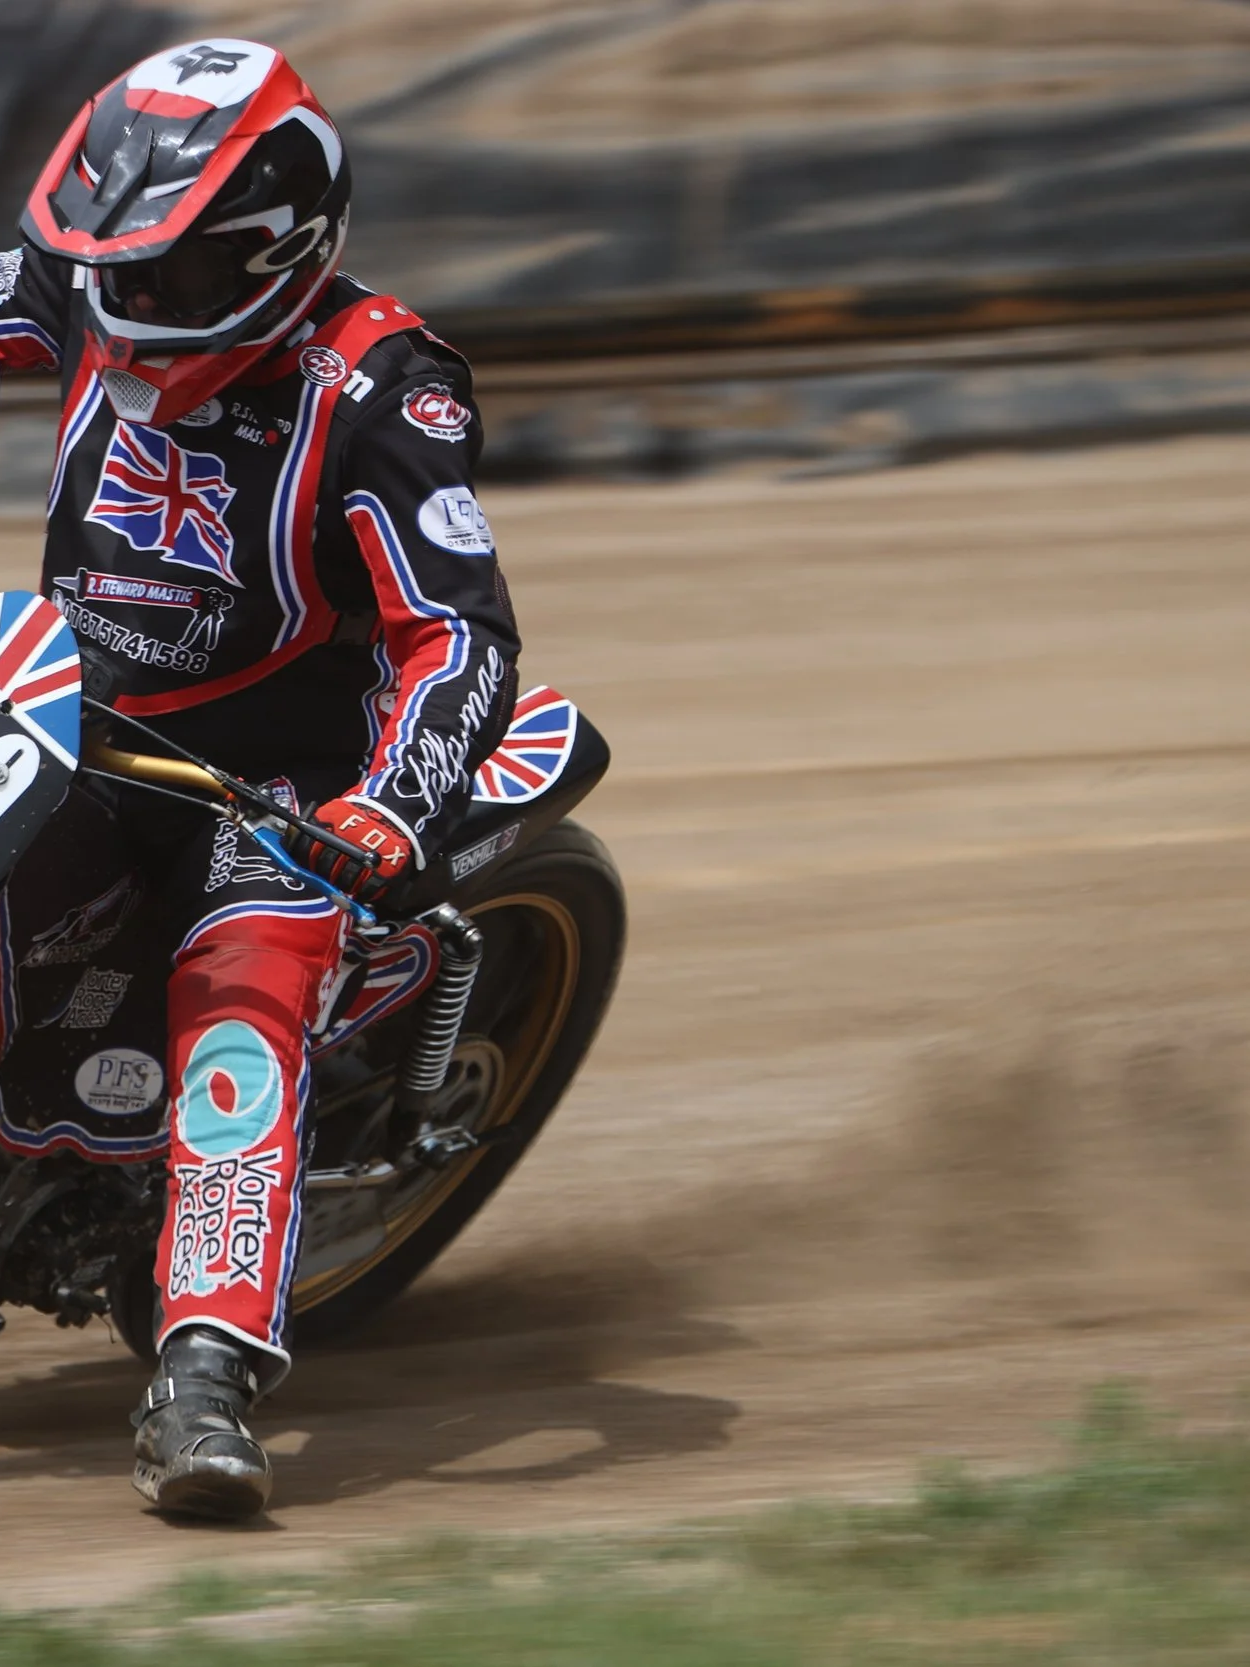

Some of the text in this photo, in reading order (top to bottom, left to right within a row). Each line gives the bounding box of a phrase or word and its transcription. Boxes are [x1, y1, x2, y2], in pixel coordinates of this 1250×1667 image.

[98, 579, 147, 598] STEWARD
[146, 586, 195, 603] MASTIC
[62, 598, 209, 674] 07875741598
[339, 814, 405, 866] FOX
[452, 839, 497, 877] VENHILL
[96, 1059, 148, 1088] PFS
[171, 1168, 202, 1295] Access
[197, 1158, 239, 1260] Rope
[230, 1153, 278, 1281] Vortex
